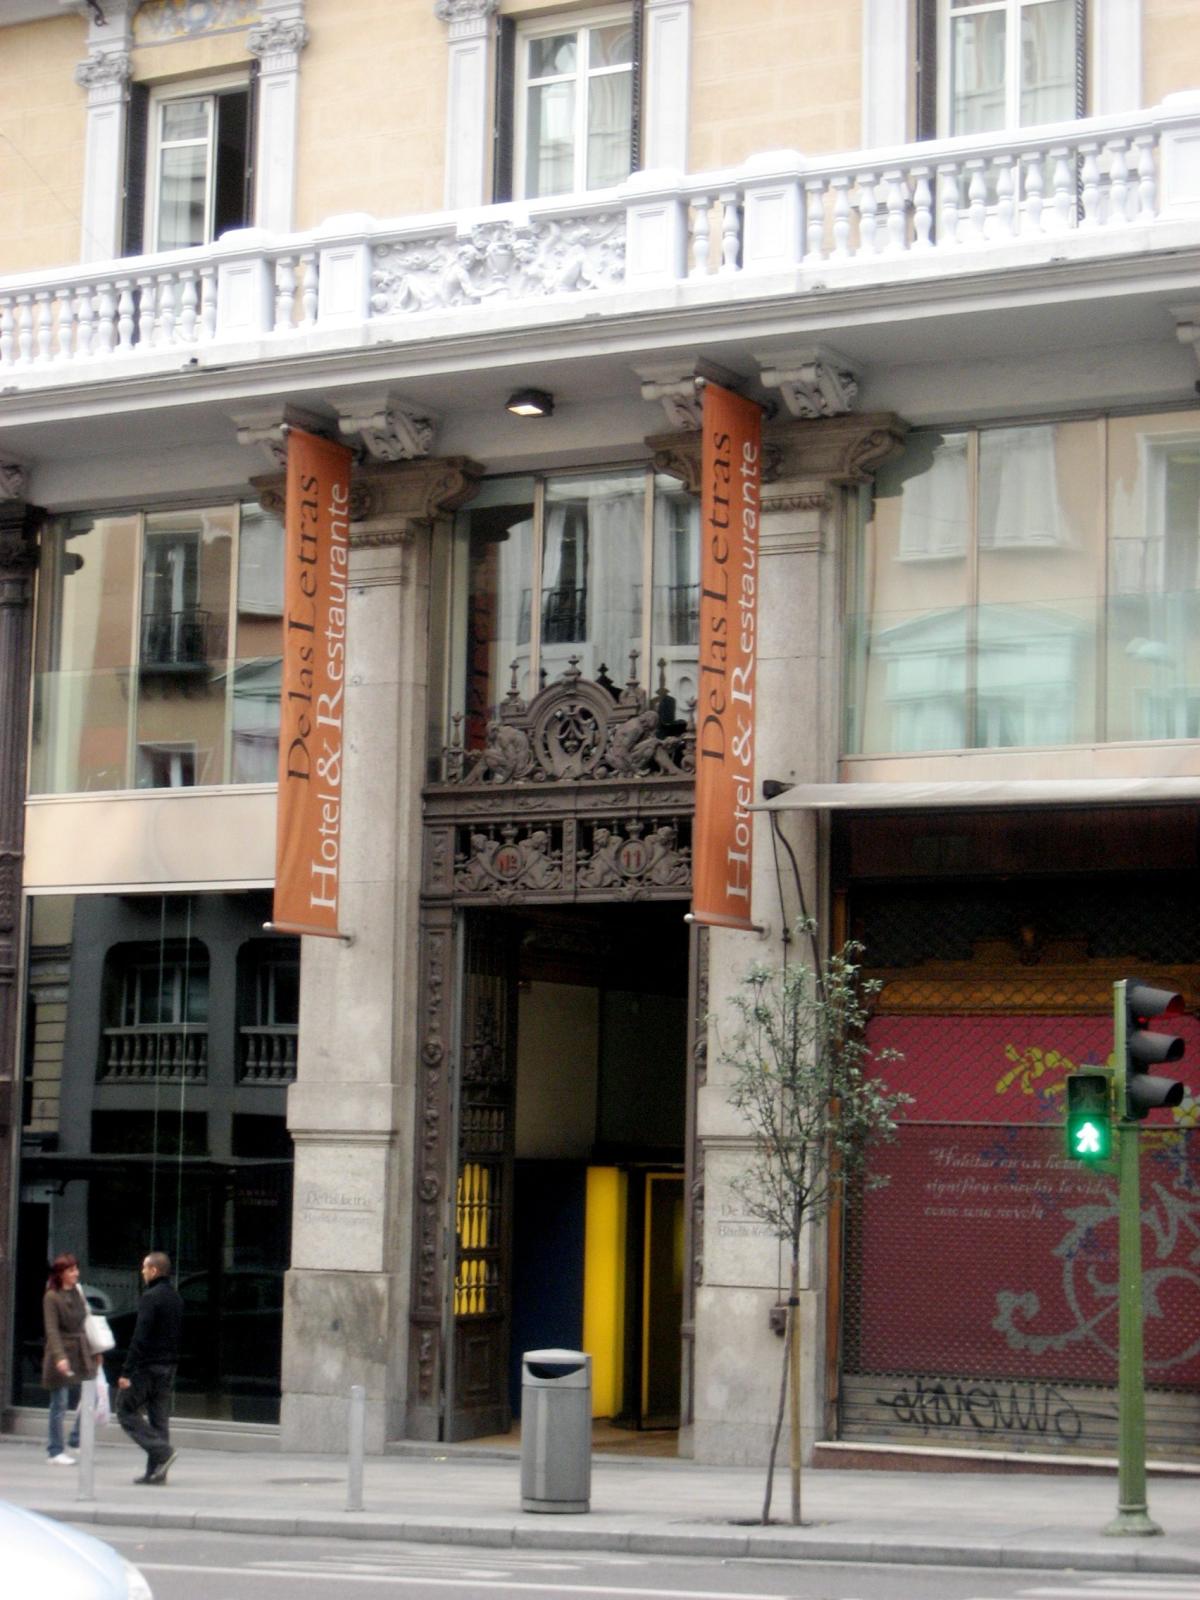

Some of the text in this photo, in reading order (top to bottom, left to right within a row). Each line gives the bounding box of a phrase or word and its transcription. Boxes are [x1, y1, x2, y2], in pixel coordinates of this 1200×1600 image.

[286, 474, 319, 783] De las Letras
[310, 483, 349, 913] Hotel & Restaurante
[701, 432, 731, 766] De las Letras
[726, 441, 758, 902] Hotel & Restaurante
